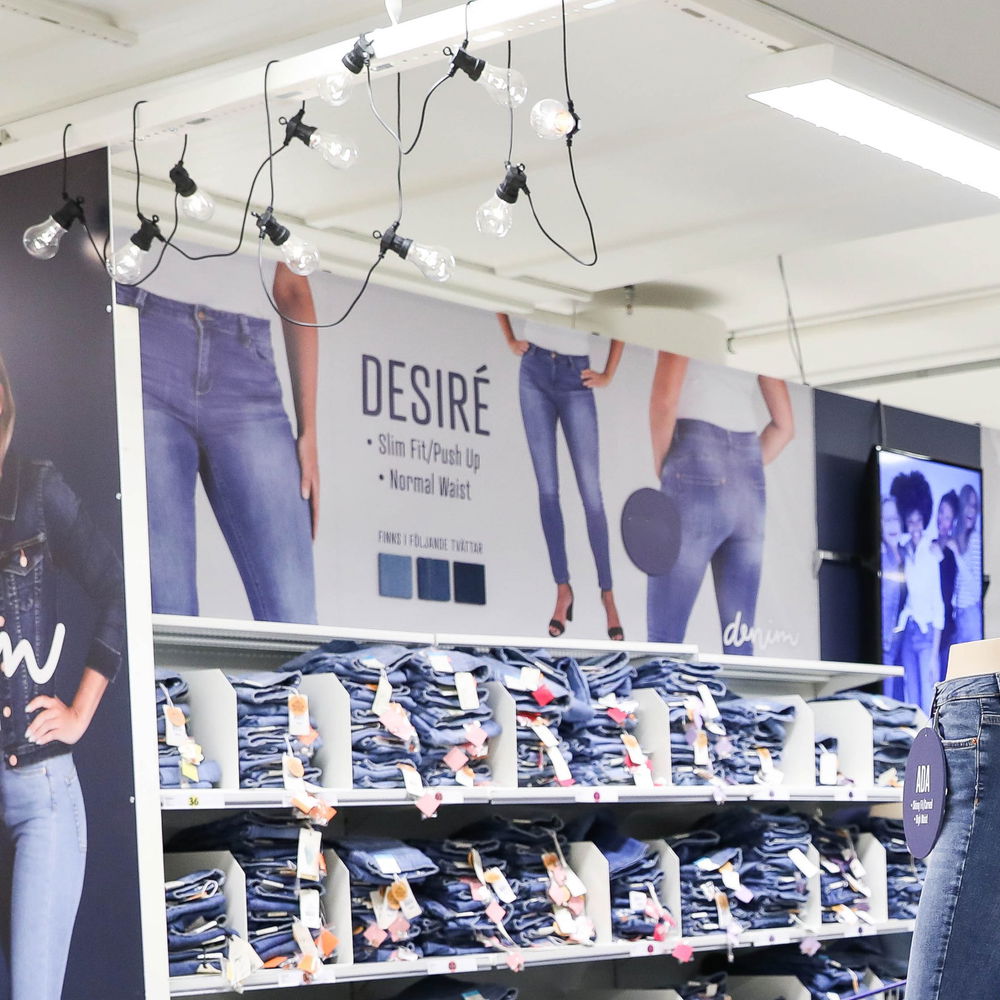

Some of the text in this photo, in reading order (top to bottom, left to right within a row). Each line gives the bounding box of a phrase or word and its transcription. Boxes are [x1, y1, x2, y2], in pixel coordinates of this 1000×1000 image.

[362, 354, 490, 436] DESIRÉ
[379, 432, 480, 475] Slim Fit/Push Up
[390, 469, 471, 501] Normal Waist
[723, 611, 800, 651] denim
[915, 764, 931, 793] ADA
